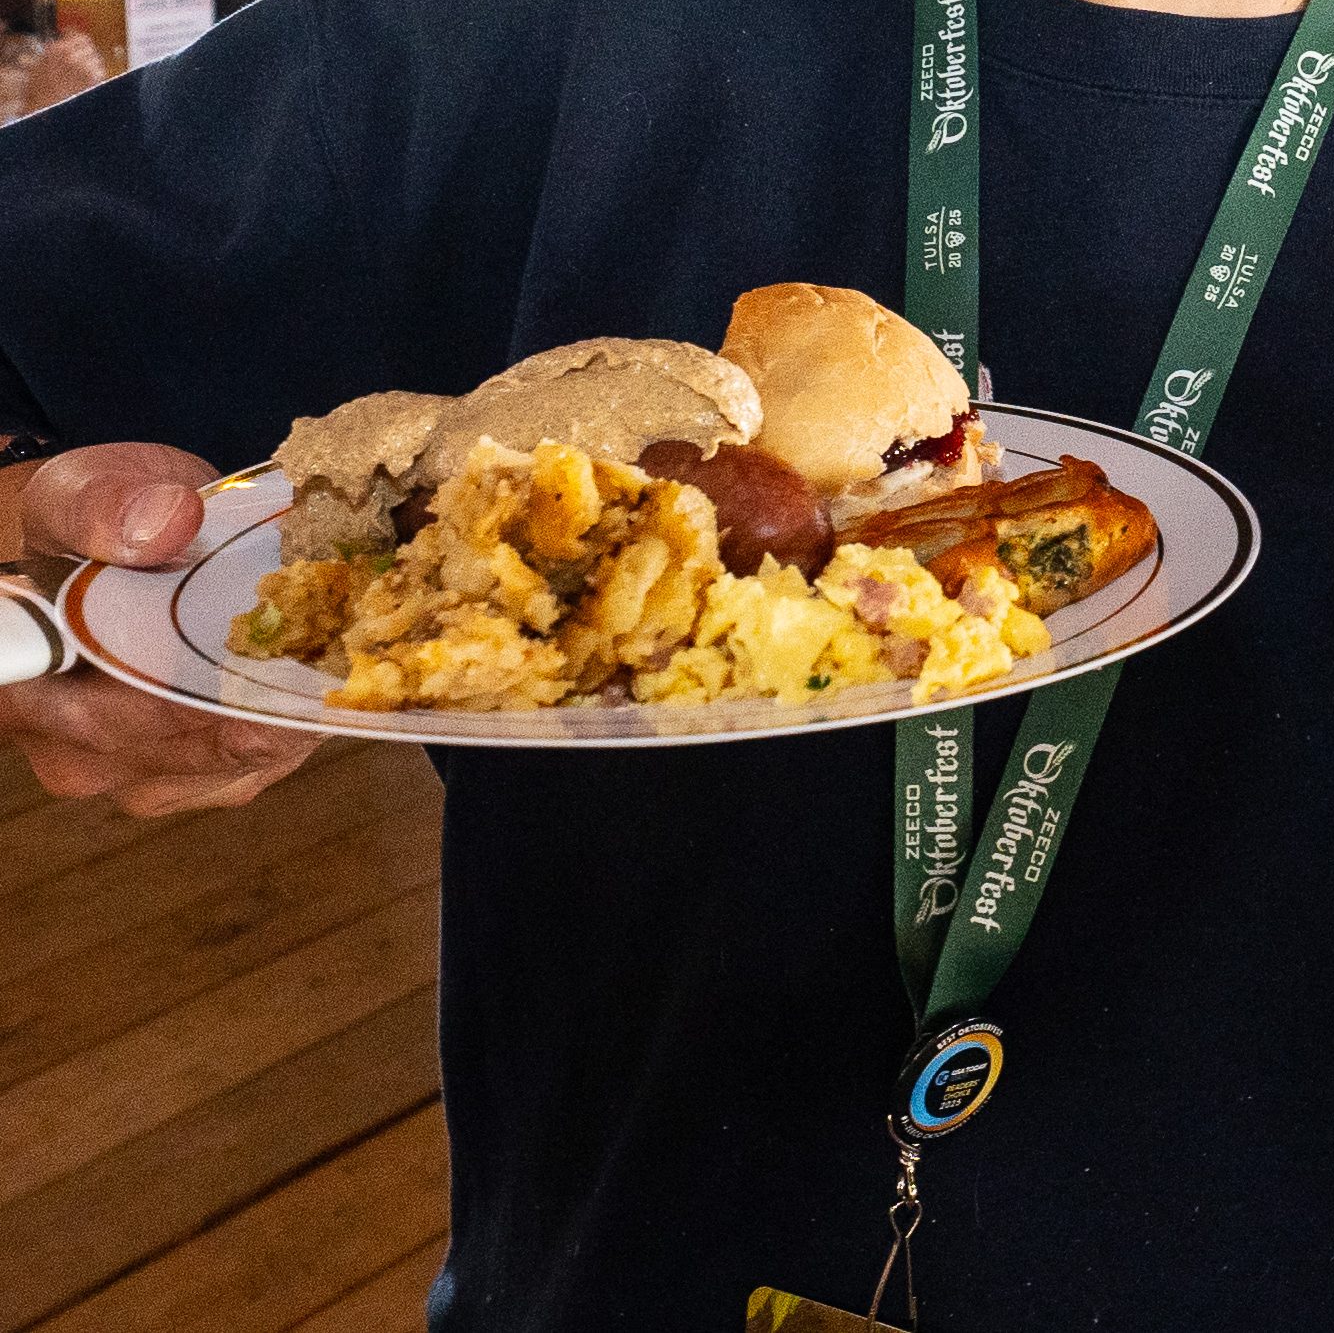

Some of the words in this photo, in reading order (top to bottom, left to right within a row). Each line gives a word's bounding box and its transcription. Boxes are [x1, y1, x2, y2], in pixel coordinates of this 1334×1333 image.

[920, 43, 935, 101] ZEECO
[1295, 102, 1328, 162] ZEECO
[924, 211, 940, 271] TULSA
[949, 209, 962, 226] 25
[949, 252, 962, 268] 20
[1219, 244, 1237, 262] 20
[1225, 254, 1259, 308] TULSA
[1204, 284, 1220, 303] 25
[906, 784, 921, 860] ZEECO
[914, 723, 967, 925] Oktoberfest
[969, 740, 1077, 933] Oktoberfest
[1024, 807, 1061, 883] ZEECO
[936, 1032, 956, 1050] BEST
